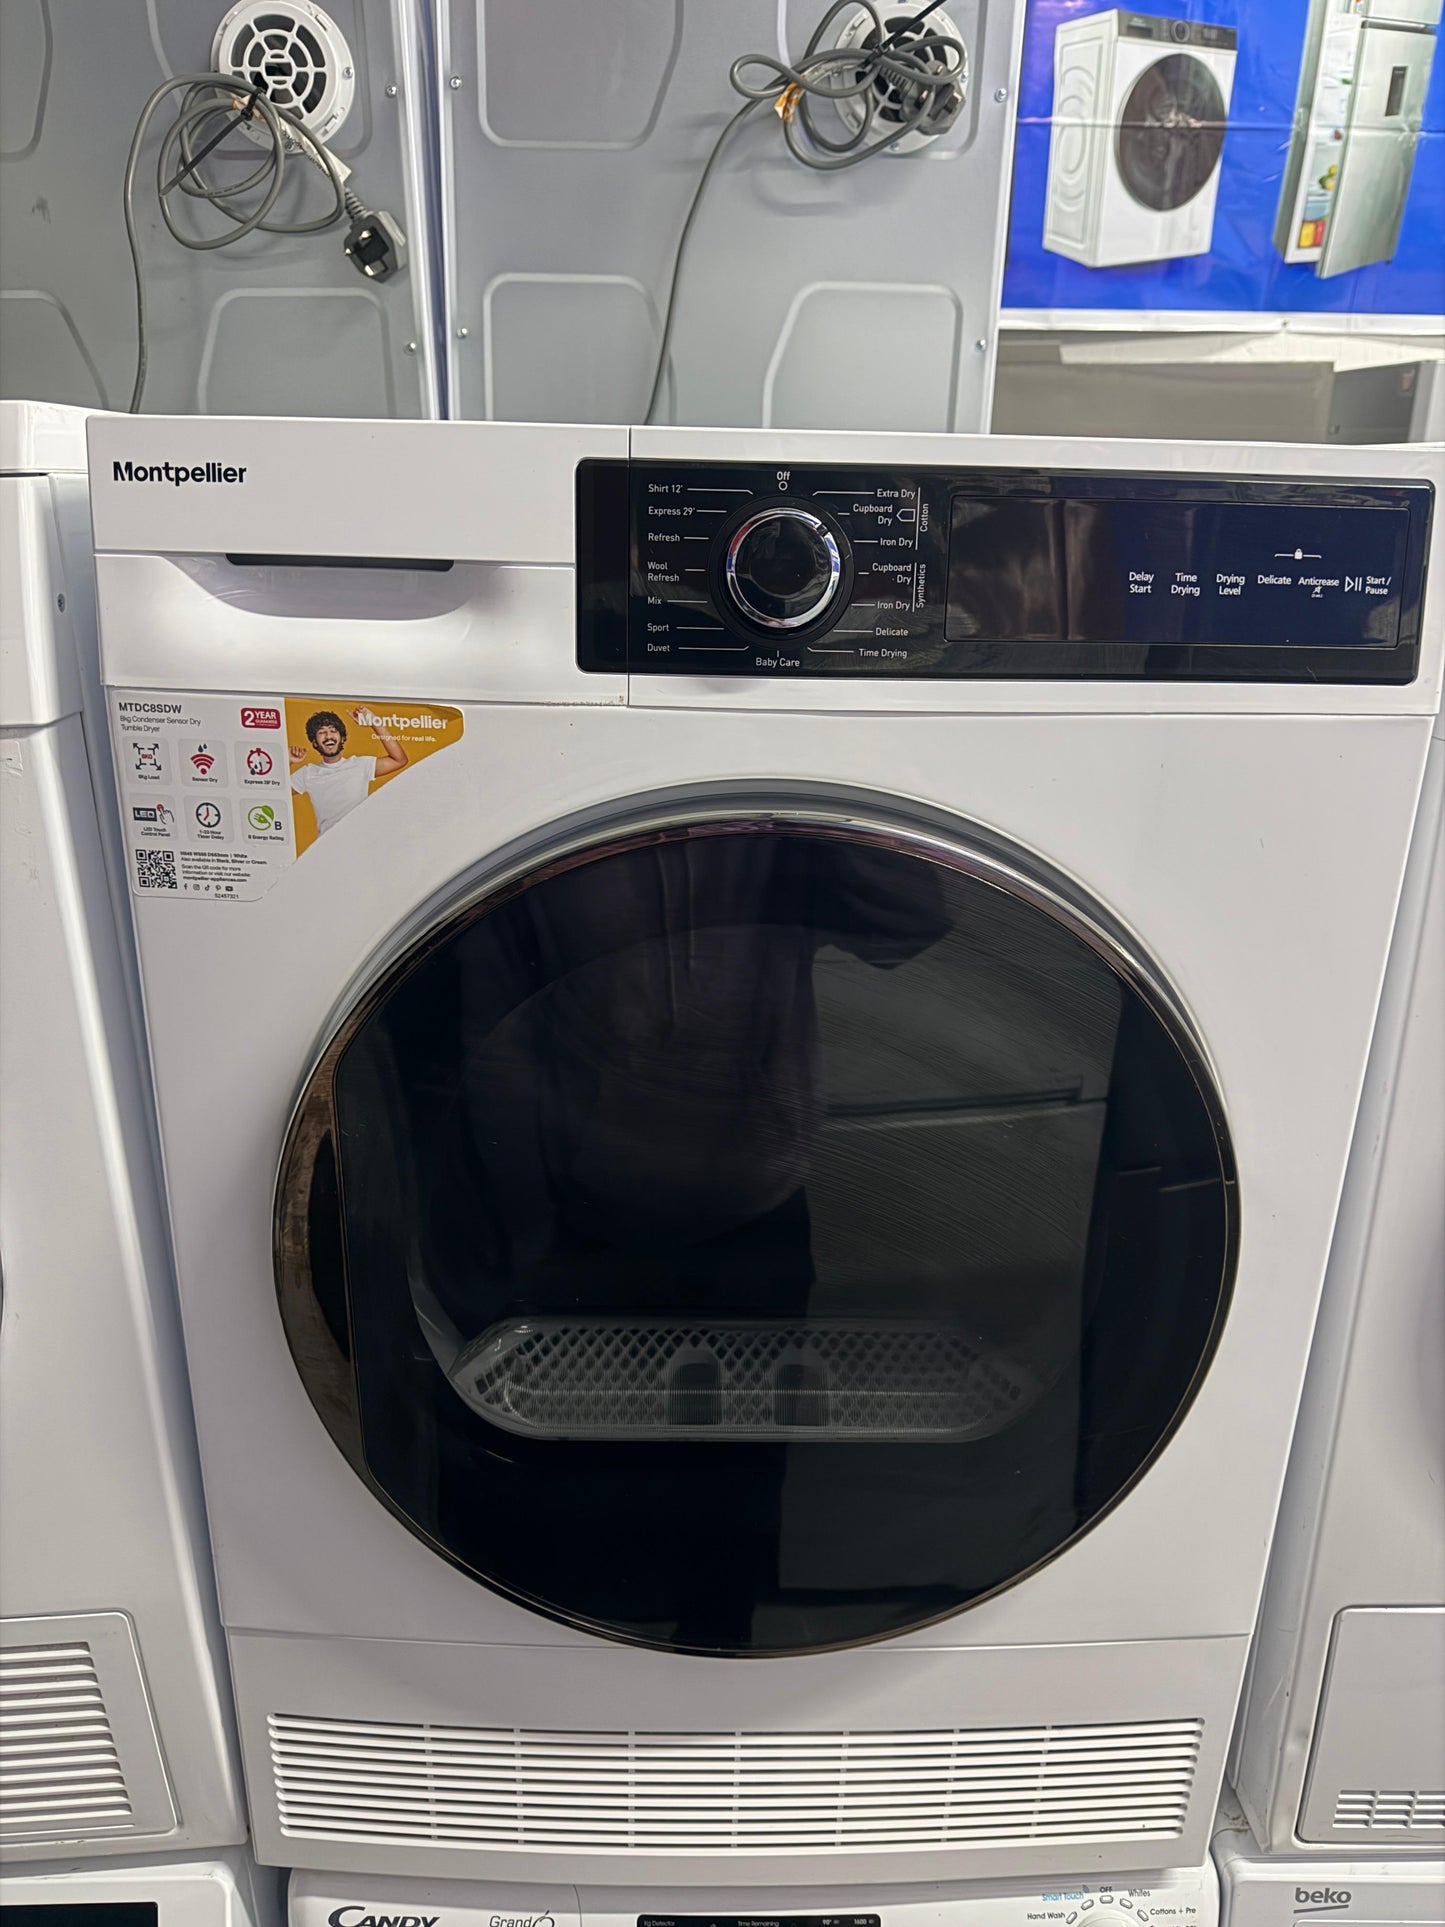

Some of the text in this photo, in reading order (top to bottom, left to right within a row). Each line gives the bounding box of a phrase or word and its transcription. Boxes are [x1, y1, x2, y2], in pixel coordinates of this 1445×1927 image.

[113, 461, 247, 487] Montpellier
[776, 471, 791, 481] Off
[648, 484, 669, 493] Shirt
[877, 489, 916, 500] Extra Dry
[648, 506, 681, 517] Express
[853, 504, 893, 514] Cupboard
[877, 516, 893, 526] Dry
[920, 503, 929, 532] Cotton
[648, 532, 681, 542] Refresh
[880, 537, 913, 548] Iron Dry
[647, 562, 668, 570] Wool
[872, 562, 912, 573] Cupboard
[647, 573, 680, 582] Refresh
[896, 575, 912, 585] Dry
[1129, 571, 1155, 583] Delay
[1175, 572, 1198, 582] Time
[1216, 573, 1246, 585] Drying
[1257, 575, 1292, 585] Delicate
[1298, 576, 1340, 586] Anticrease
[1366, 575, 1386, 585] Start
[916, 563, 926, 608] Synthetics
[1129, 583, 1152, 594] Start
[1171, 584, 1200, 597] Drying
[1219, 585, 1241, 596] Level
[1365, 586, 1388, 595] Pause
[647, 597, 662, 605] Mix
[877, 601, 910, 611] Iron Dry
[647, 623, 670, 633] Sport
[875, 627, 909, 636] Delicate
[647, 643, 671, 652] Duvet
[859, 648, 907, 659] Time Drying
[755, 657, 800, 668] Baby Care
[118, 702, 182, 714] MTDC8SDW
[132, 715, 166, 724] Condenser
[166, 717, 189, 725] Sensor
[189, 718, 201, 726] Dry
[243, 710, 277, 726] 2 YEAR
[358, 713, 448, 730] Montpellier
[121, 724, 160, 733] Tumble Dryer
[371, 734, 401, 742] Designed
[134, 809, 156, 819] LED
[274, 821, 283, 831] B
[1042, 1892, 1084, 1902] Smart Touch
[1128, 1889, 1151, 1898] Whites
[1295, 1887, 1352, 1904] beko
[328, 1905, 440, 1927] CANDY
[1027, 1911, 1066, 1920] Hand Wash
[1150, 1908, 1176, 1916] Cottons
